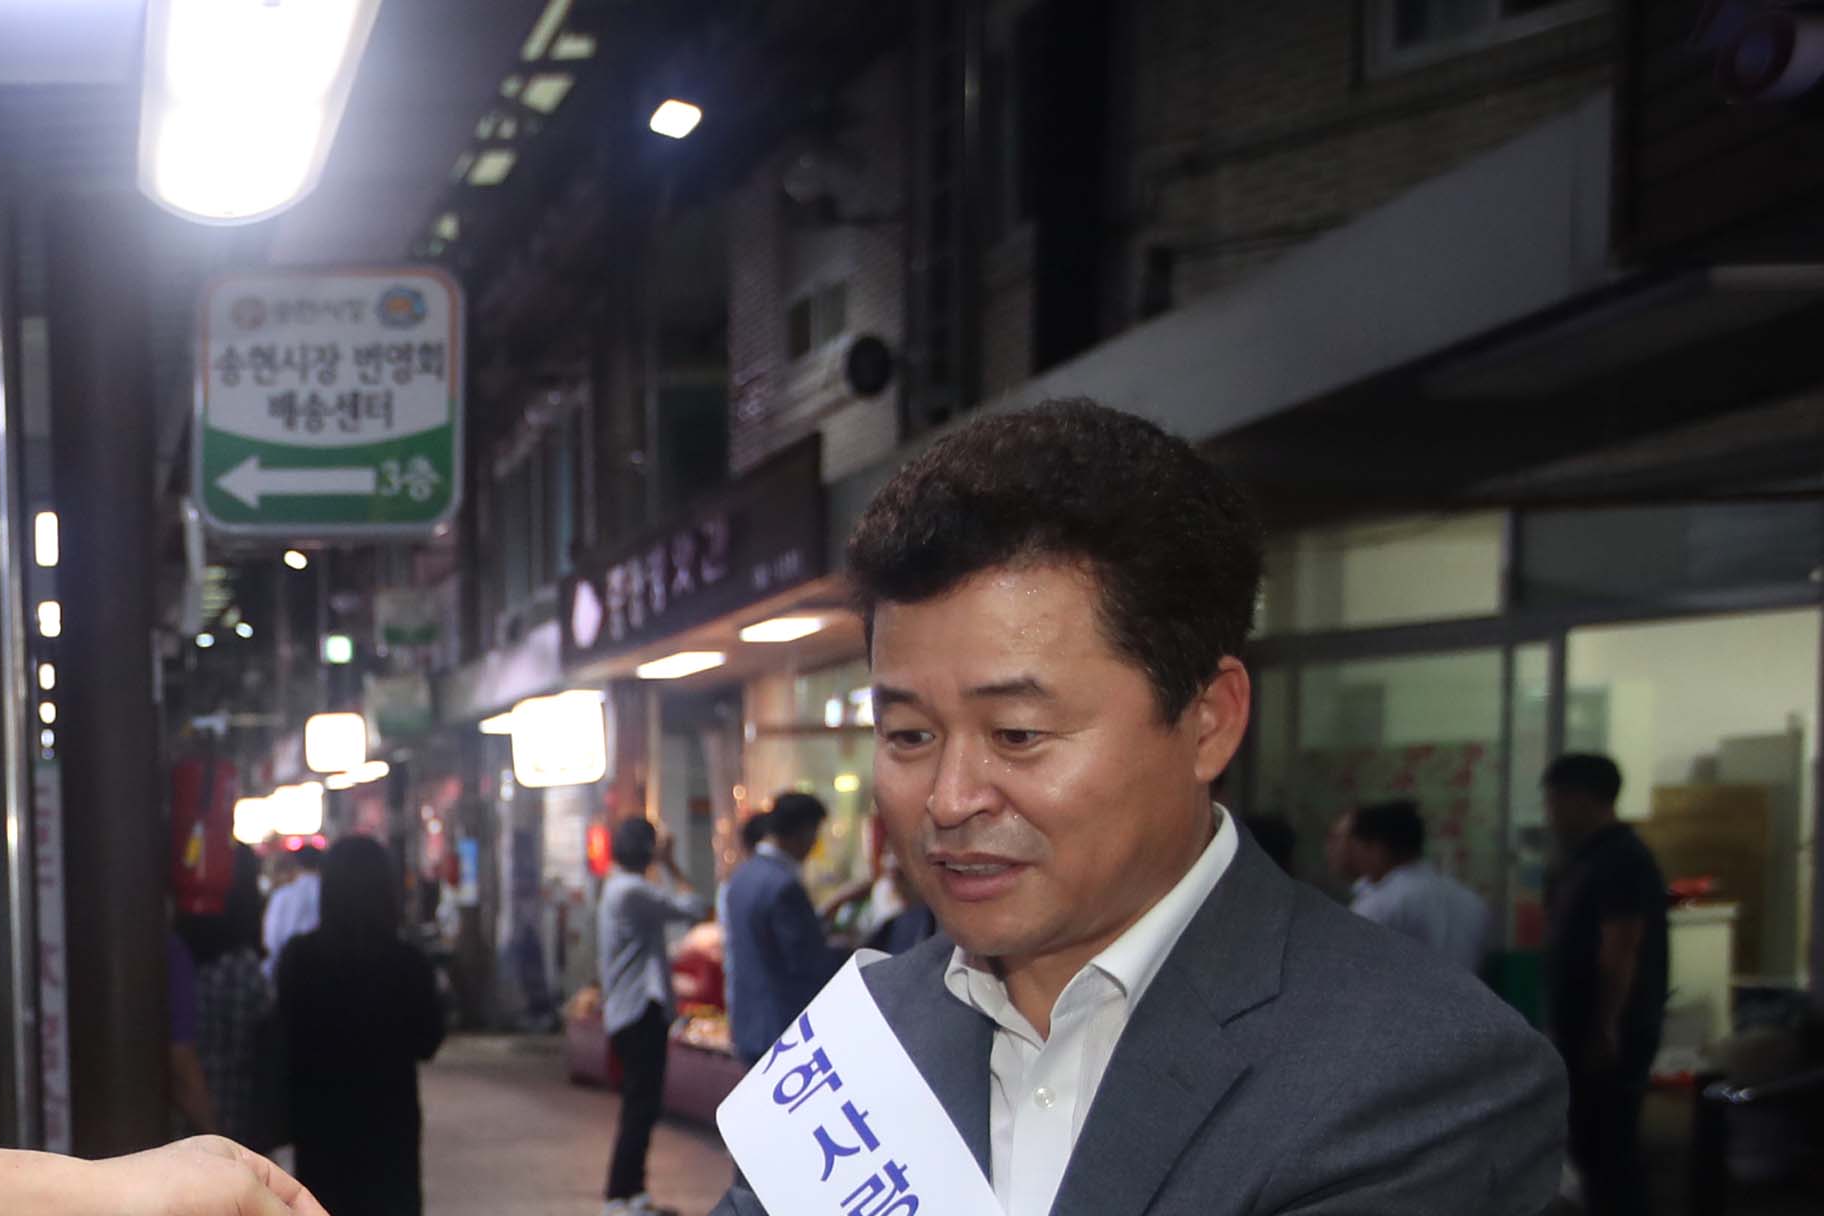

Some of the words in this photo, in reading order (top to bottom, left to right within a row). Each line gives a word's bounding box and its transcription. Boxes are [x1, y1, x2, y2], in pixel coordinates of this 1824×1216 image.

[214, 342, 342, 387] 송현시장
[352, 340, 445, 386] 번영회
[267, 388, 395, 433] 배송센터
